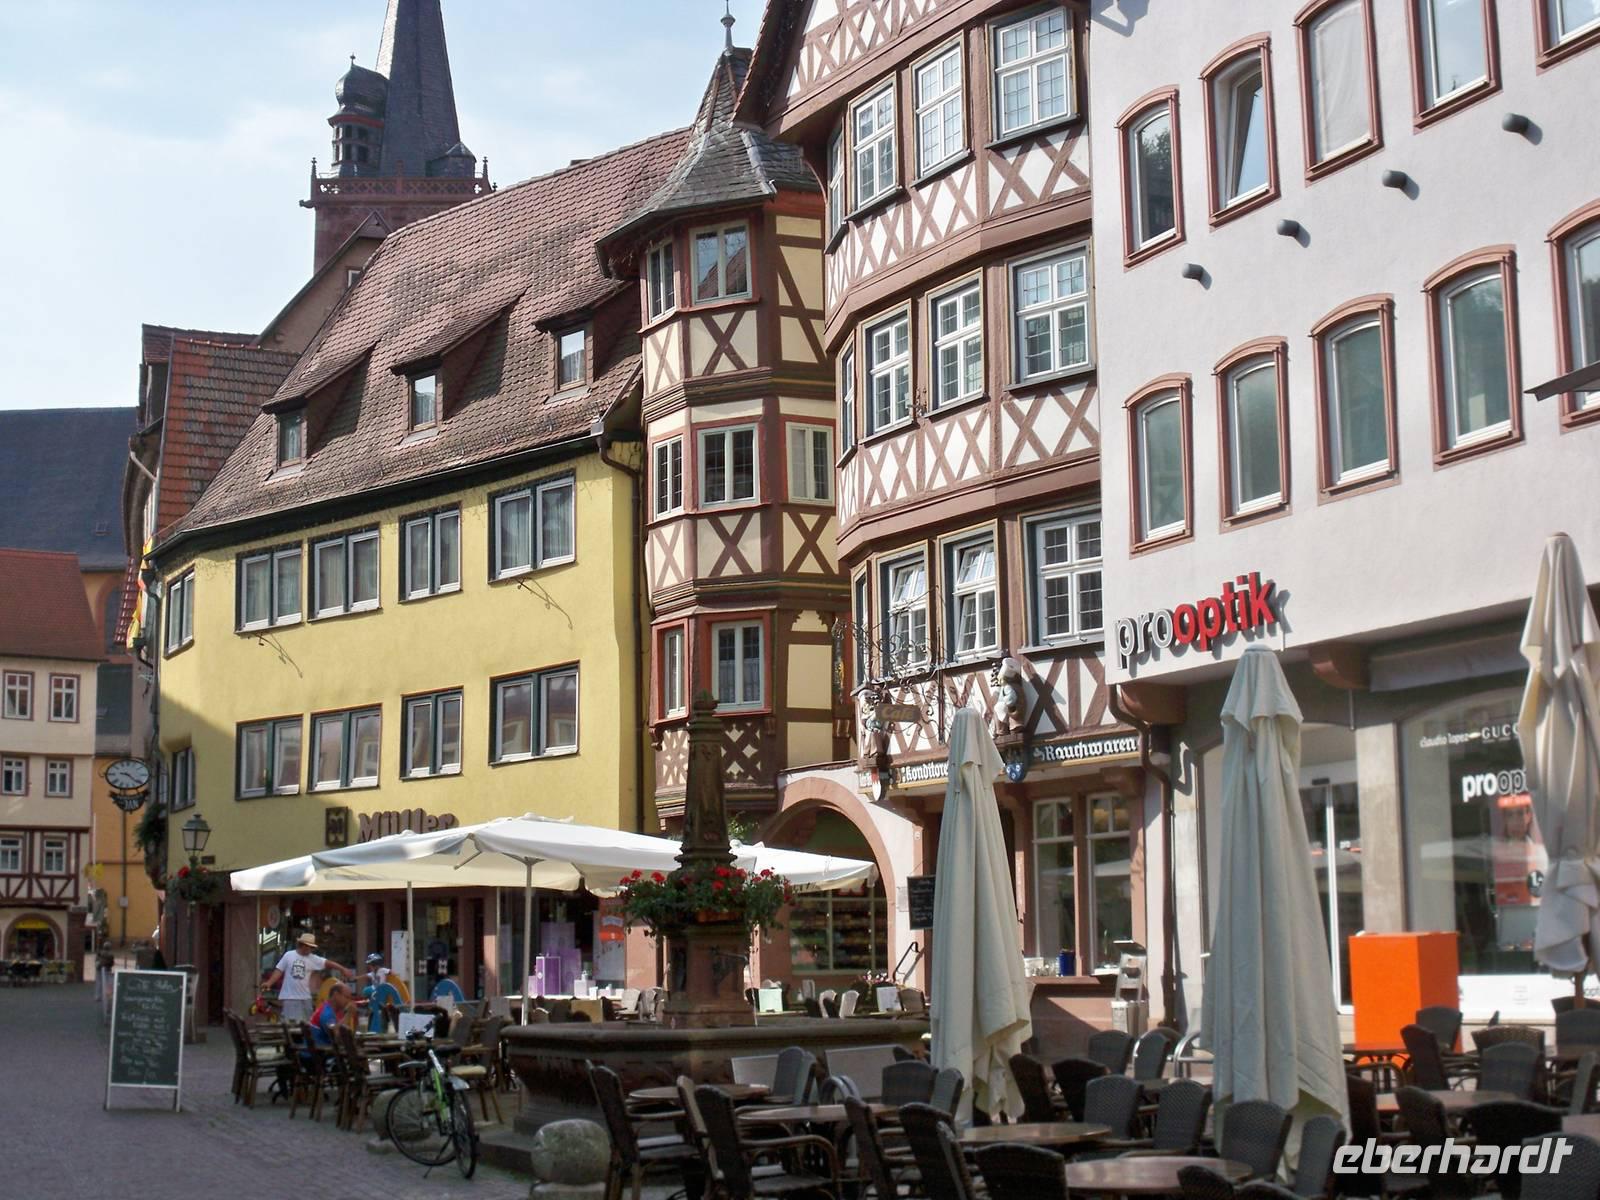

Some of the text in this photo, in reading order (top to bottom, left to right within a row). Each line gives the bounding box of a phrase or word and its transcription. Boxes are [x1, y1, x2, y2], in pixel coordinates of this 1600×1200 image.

[1115, 571, 1276, 670] prooptik
[1481, 723, 1520, 741] GUCC
[1044, 737, 1137, 761] Rauchwaren
[905, 761, 950, 781] Konditore
[1462, 769, 1528, 803] proop
[357, 808, 457, 843] Müller
